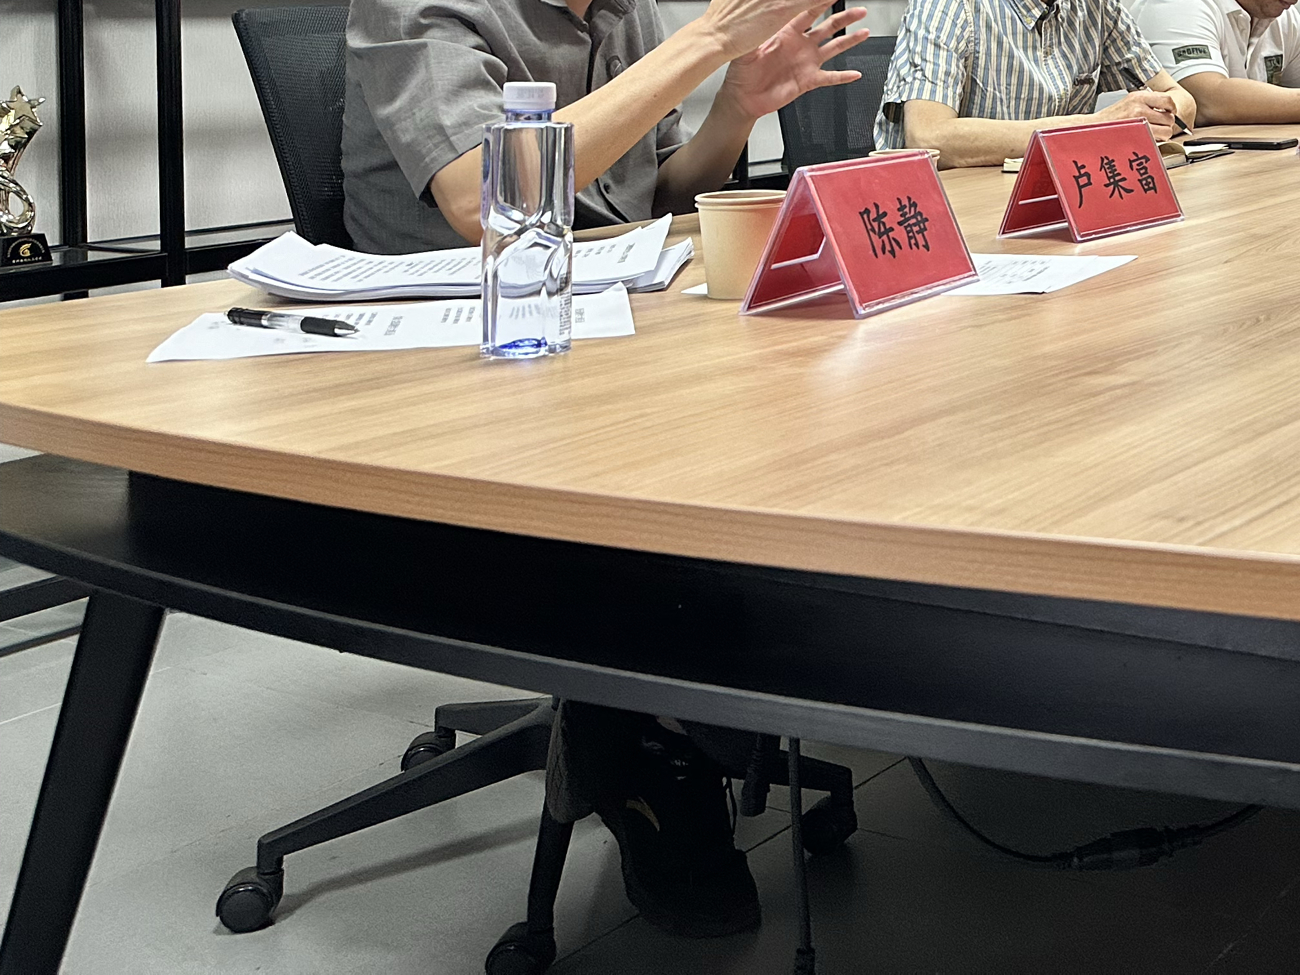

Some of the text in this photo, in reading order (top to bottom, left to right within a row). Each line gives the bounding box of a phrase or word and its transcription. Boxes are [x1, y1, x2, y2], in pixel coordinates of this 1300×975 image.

[1072, 151, 1159, 209] 卢集富
[858, 195, 931, 259] 陈静
